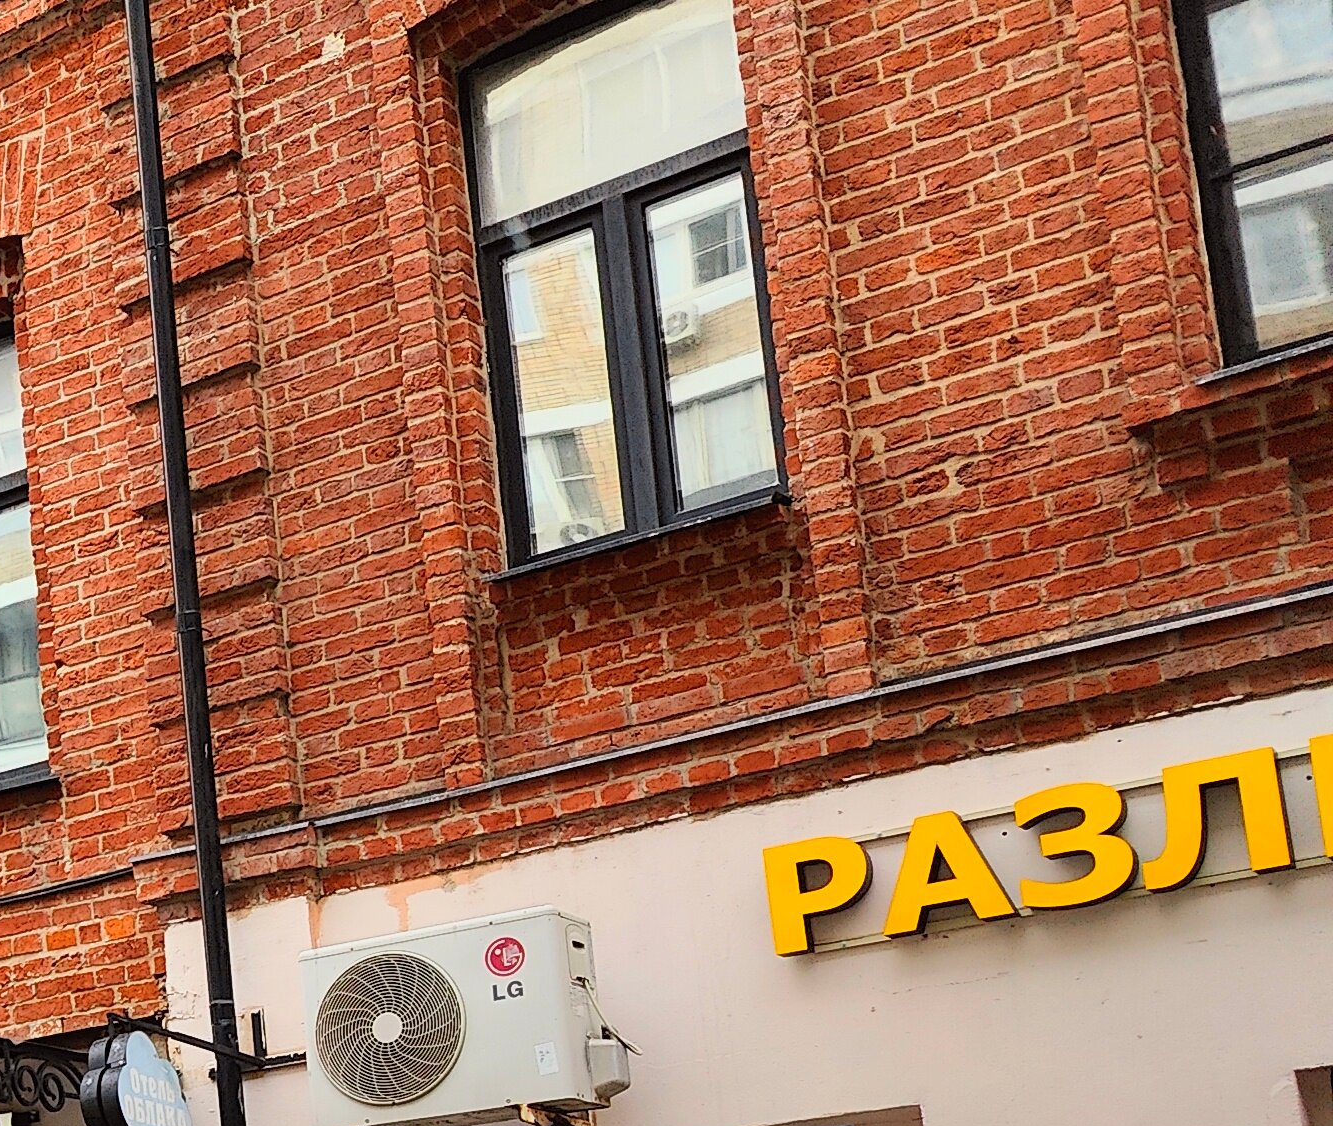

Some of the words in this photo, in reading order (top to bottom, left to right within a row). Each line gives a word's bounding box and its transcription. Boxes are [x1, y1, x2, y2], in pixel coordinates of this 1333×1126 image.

[762, 732, 1333, 958] РАЗЛ
[492, 980, 524, 1001] LG
[130, 1067, 176, 1103] Отель
